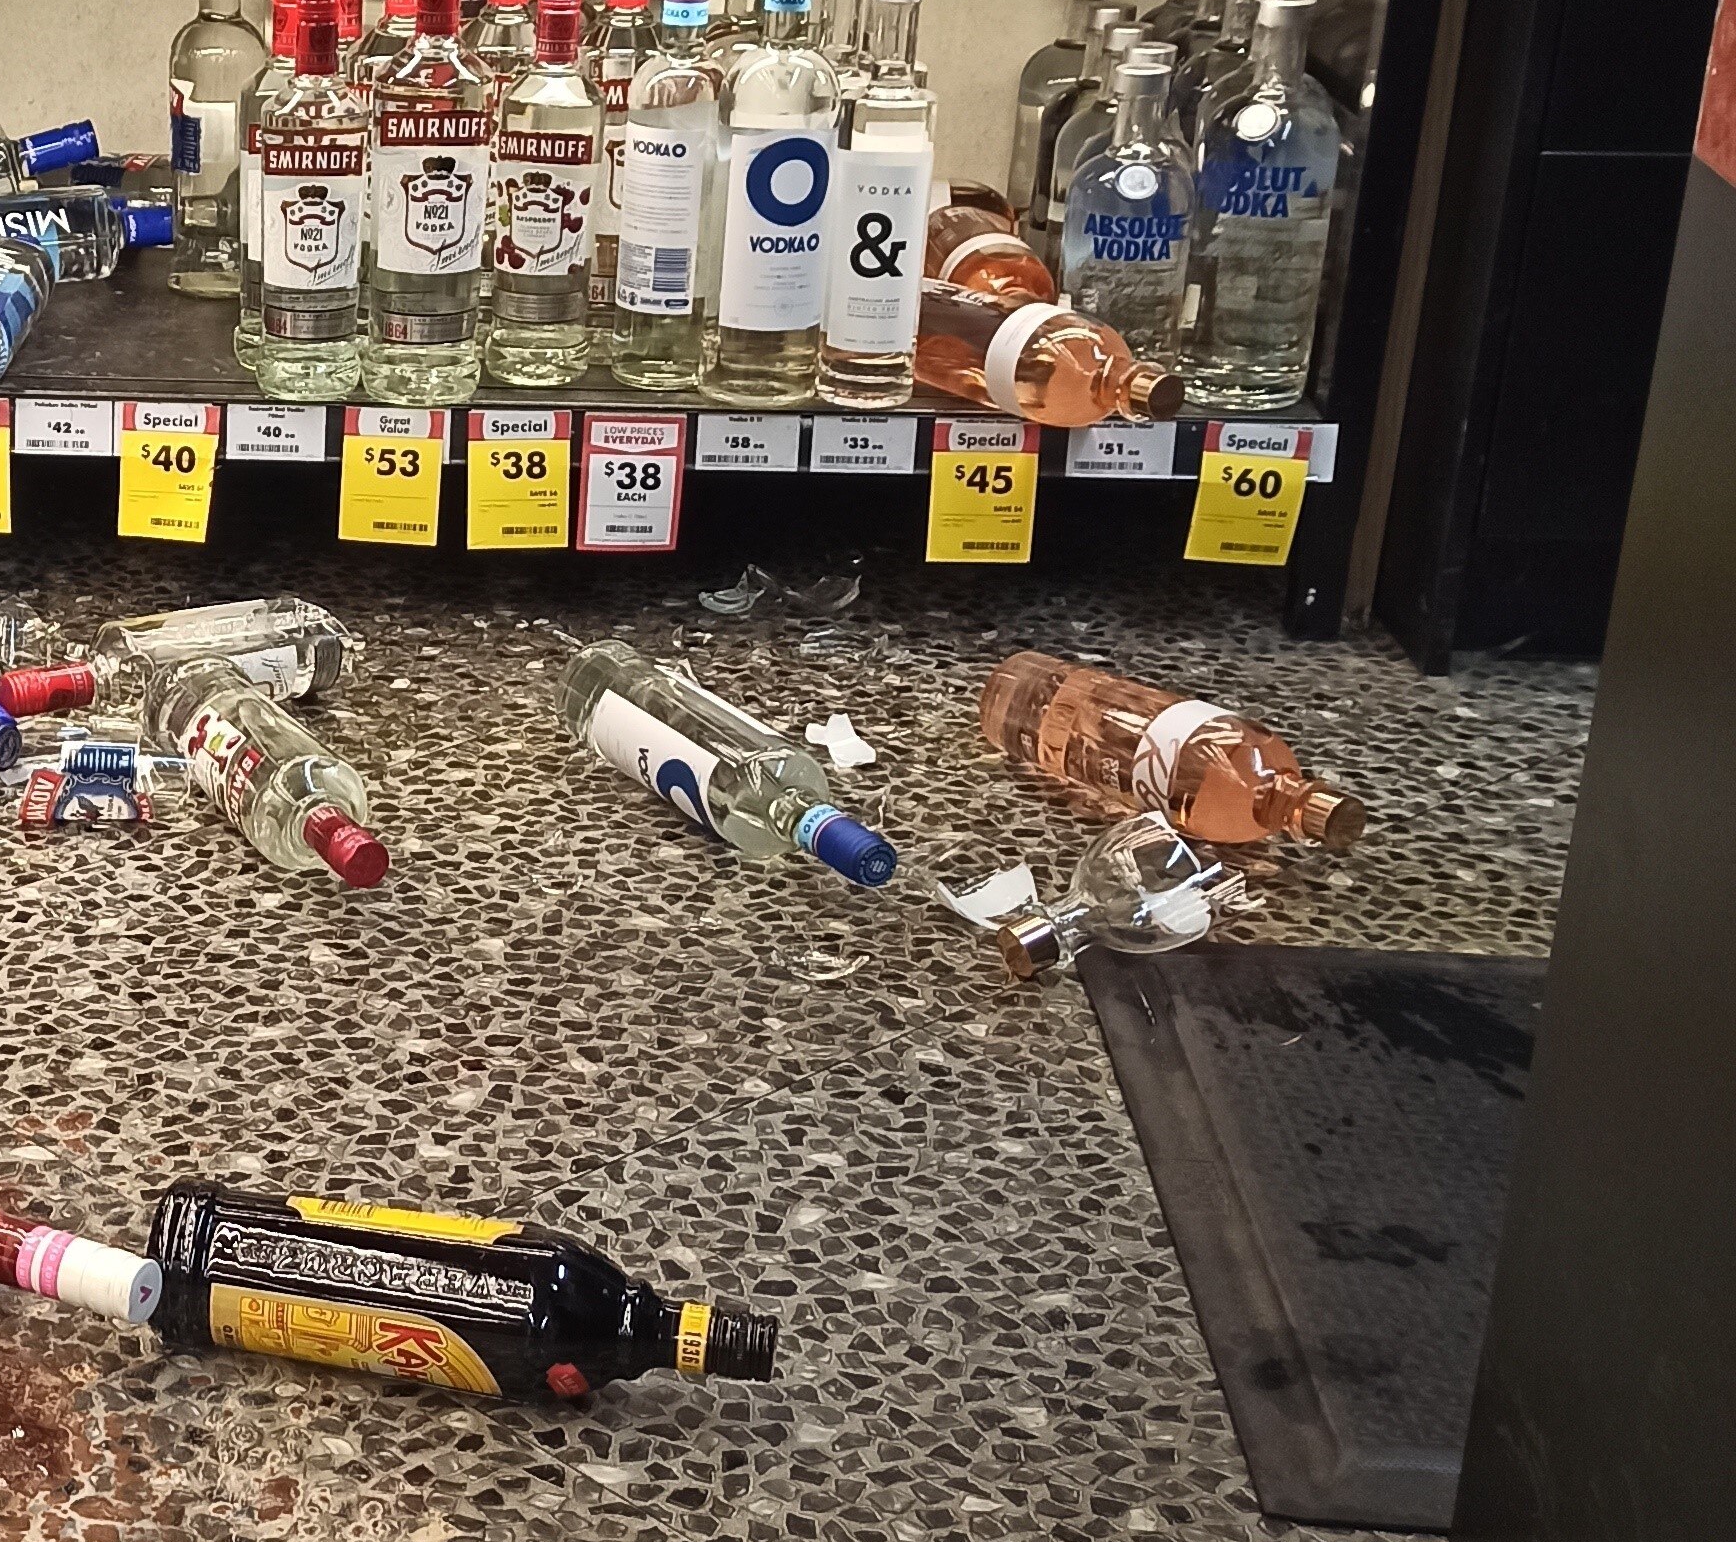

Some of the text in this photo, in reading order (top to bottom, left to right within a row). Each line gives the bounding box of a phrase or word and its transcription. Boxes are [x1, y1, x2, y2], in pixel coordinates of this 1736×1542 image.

[387, 116, 488, 140] SMIRNOFF
[269, 148, 359, 170] SMIRNOFF
[499, 136, 588, 159] SMIRNOFF
[858, 184, 913, 196] VODKA
[1084, 213, 1183, 241] ABSOLUT
[143, 412, 199, 429] Special
[379, 424, 410, 435] Value
[843, 437, 870, 451] $33
[141, 444, 196, 474] $40
[364, 448, 421, 478] $53
[490, 451, 548, 480] $38
[604, 462, 662, 491] $38
[954, 465, 1013, 495] $45
[1221, 466, 1283, 499] $60
[616, 492, 647, 503] EACH
